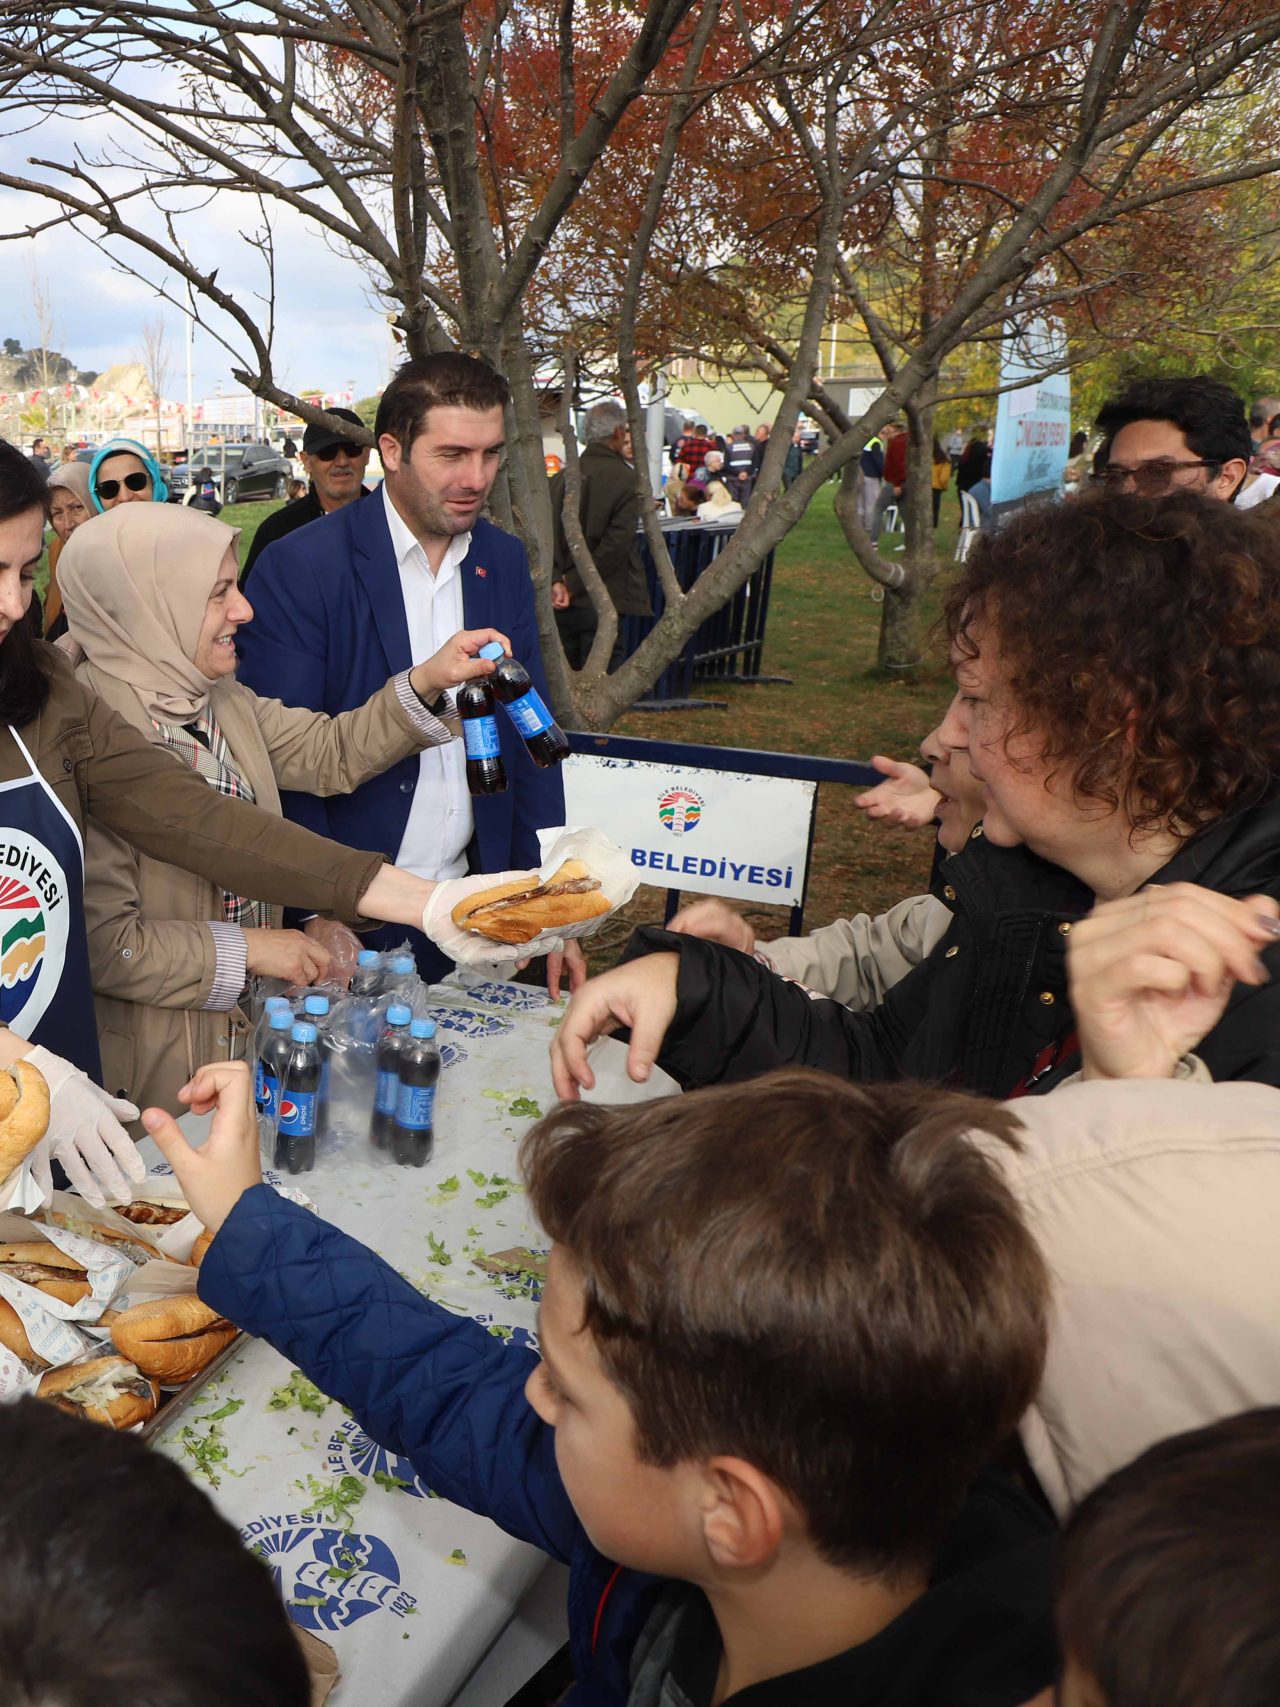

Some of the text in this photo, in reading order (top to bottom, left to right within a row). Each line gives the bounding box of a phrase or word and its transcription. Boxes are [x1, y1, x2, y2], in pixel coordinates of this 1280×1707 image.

[631, 848, 792, 889] BELEDİYESİ
[327, 1421, 358, 1452] BELE
[240, 1510, 323, 1542] EDİYESİ
[389, 1591, 418, 1618] 1923
